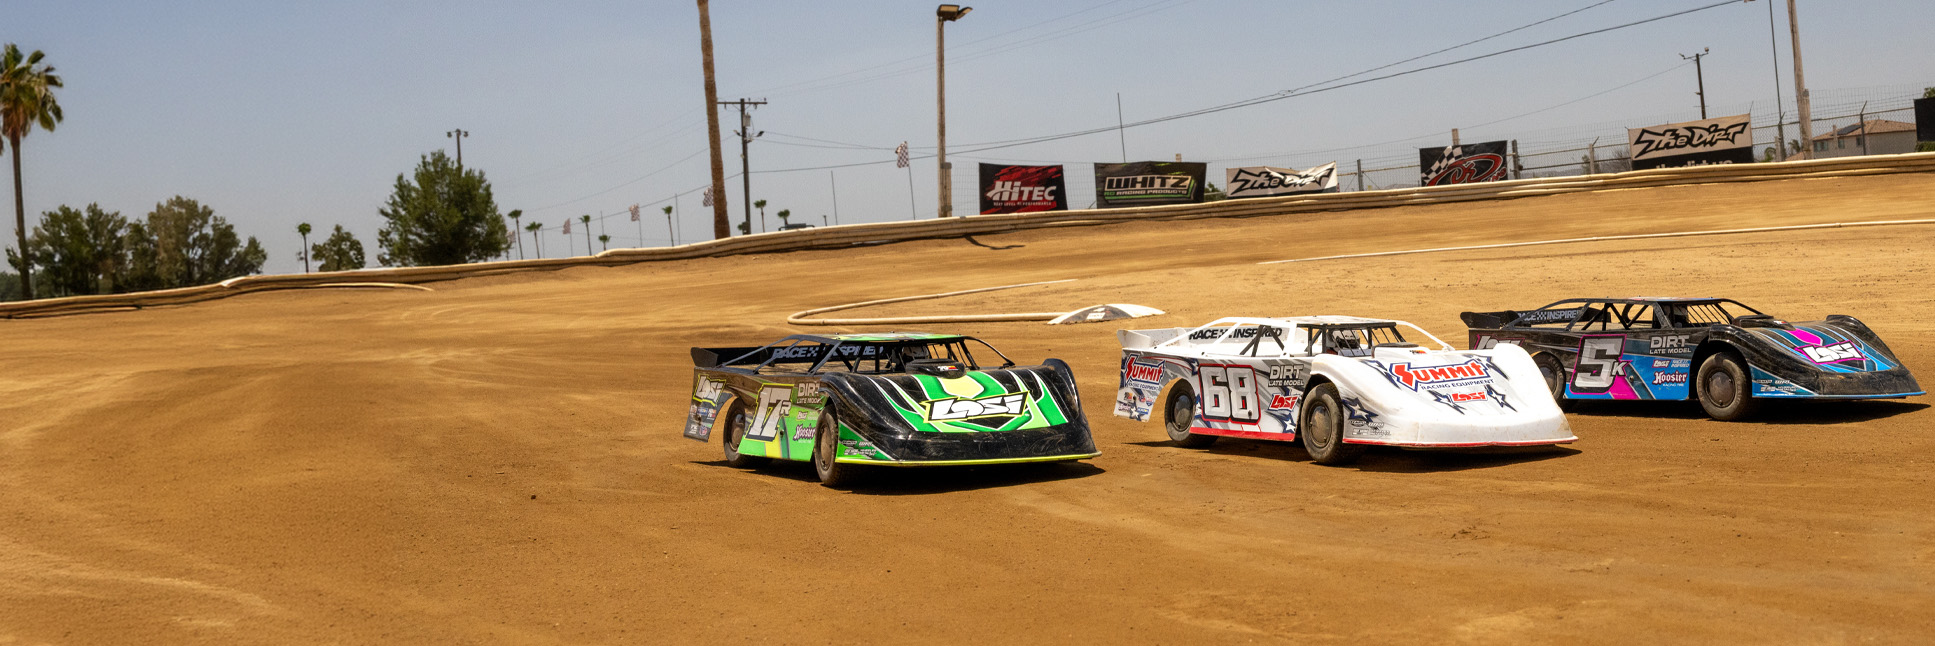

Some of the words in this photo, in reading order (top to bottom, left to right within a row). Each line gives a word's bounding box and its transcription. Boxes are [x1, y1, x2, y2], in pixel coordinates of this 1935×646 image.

[1106, 176, 1190, 189] WHITZ
[1547, 310, 1579, 320] INSPIRE
[1189, 329, 1219, 340] RACE
[1650, 335, 1690, 348] DIRT
[773, 347, 807, 358] RACE
[1270, 364, 1304, 380] DIRT
[1652, 370, 1688, 385] Hoosier
[1451, 379, 1495, 388] EQUIPMENT
[1200, 366, 1259, 420] 68
